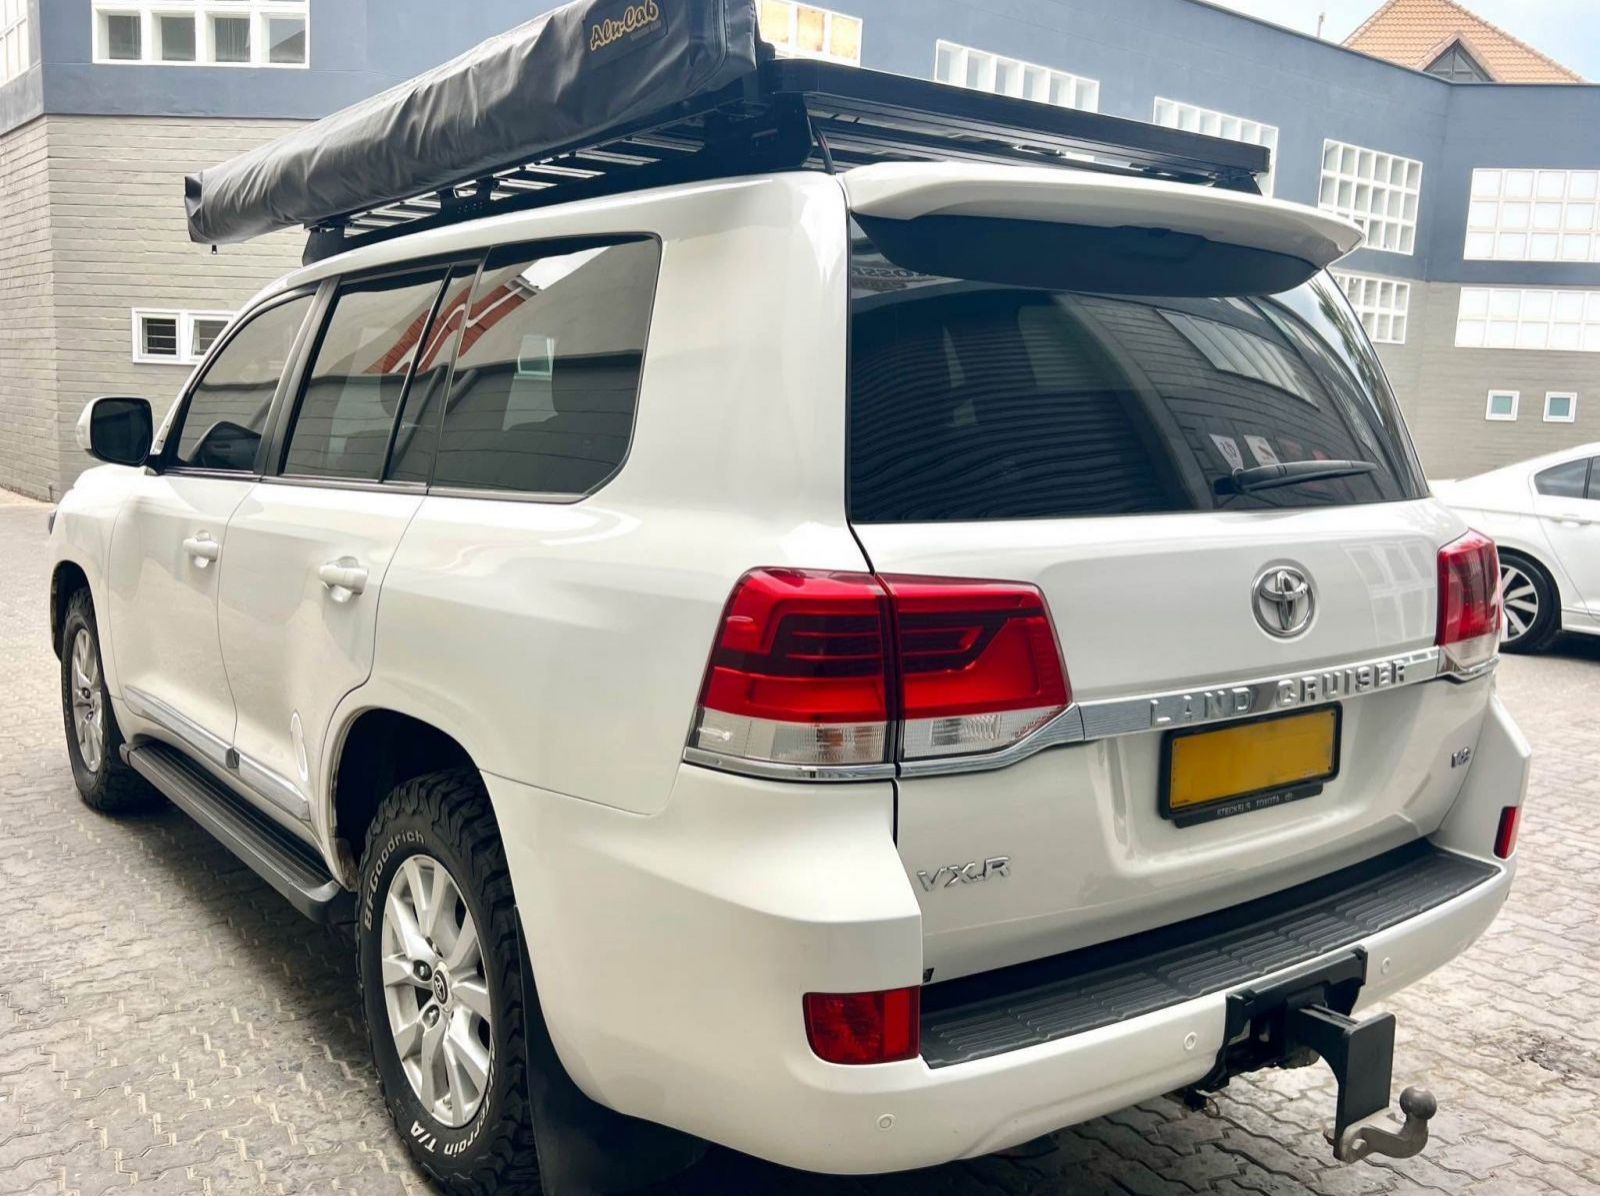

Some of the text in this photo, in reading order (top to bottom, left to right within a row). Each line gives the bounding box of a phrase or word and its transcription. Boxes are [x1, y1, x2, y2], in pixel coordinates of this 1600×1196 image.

[1150, 658, 1407, 727] LAND CRUISER
[364, 829, 425, 931] BFGoodrich
